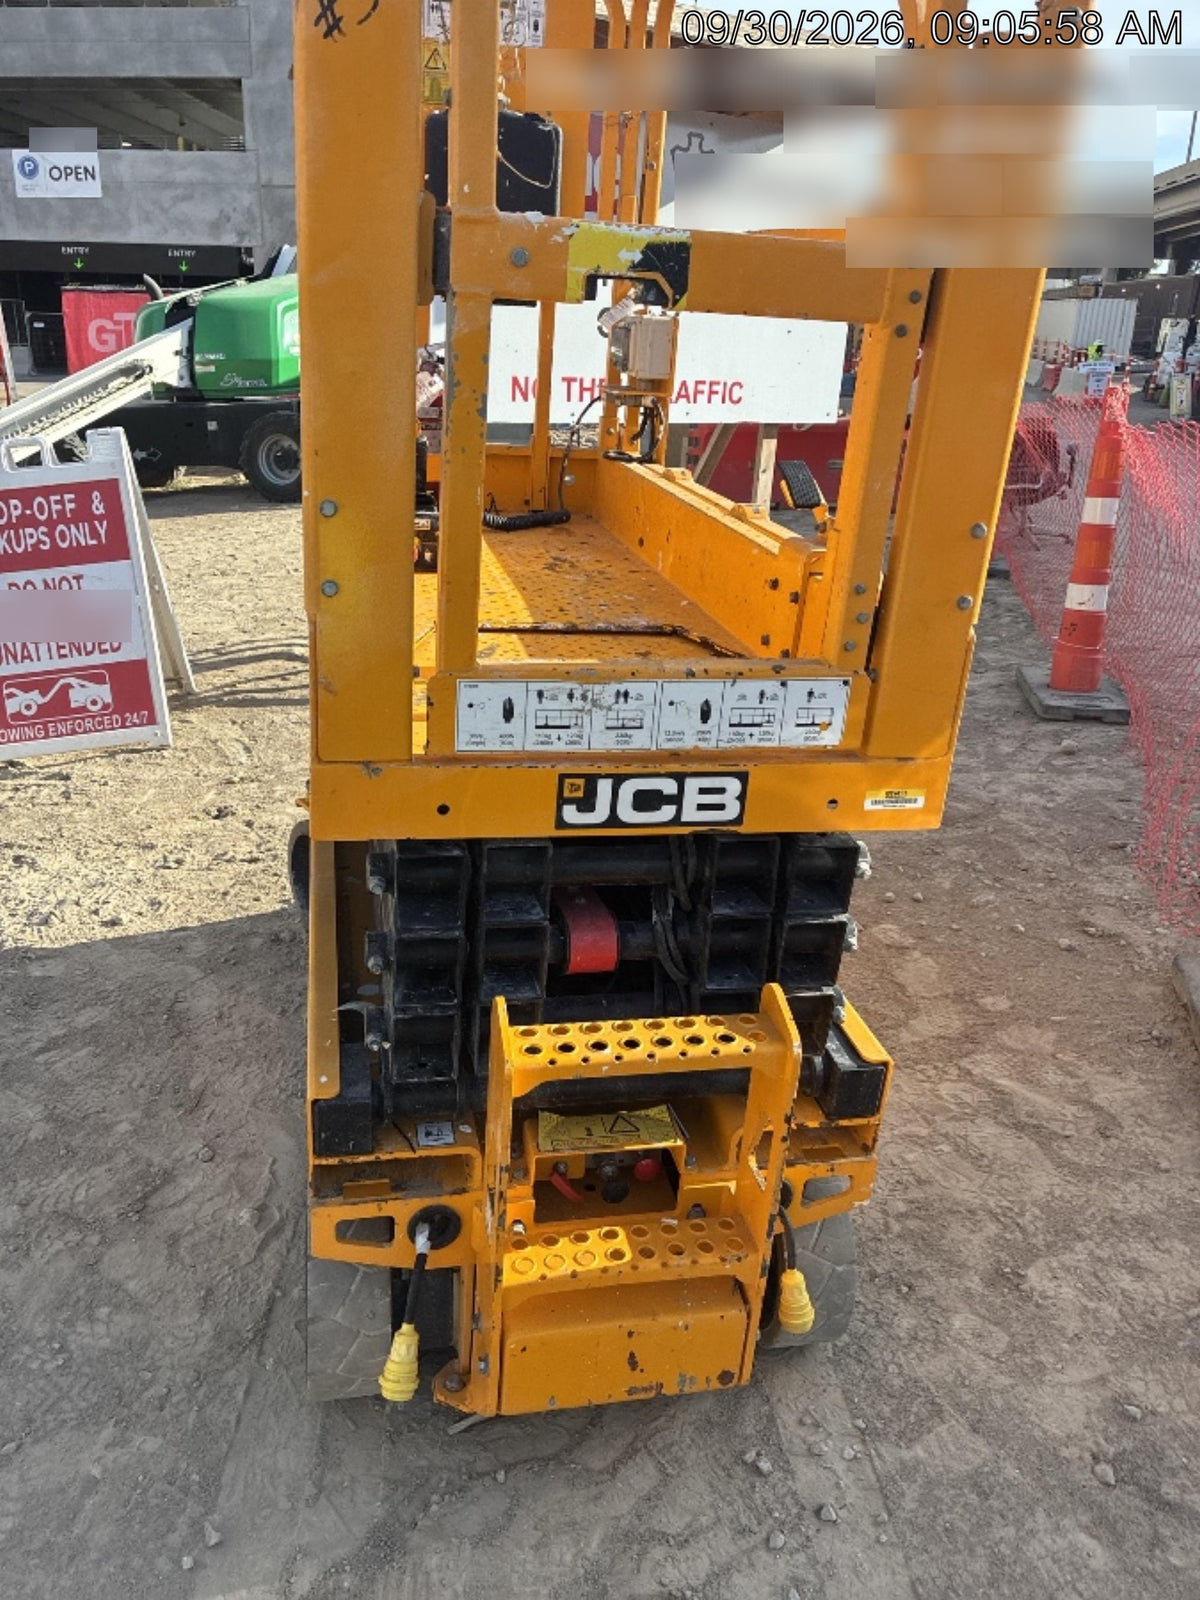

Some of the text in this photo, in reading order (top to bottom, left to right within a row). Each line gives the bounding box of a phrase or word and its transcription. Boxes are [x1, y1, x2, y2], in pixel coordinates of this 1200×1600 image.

[48, 165, 97, 182] OPEN
[61, 246, 90, 255] ENTRY
[168, 249, 196, 258] ENTRY
[511, 376, 540, 403] N
[671, 379, 745, 405] AFFIC
[91, 489, 106, 516] &
[55, 519, 108, 549] ONLY
[43, 574, 84, 590] NOT
[0, 642, 122, 668] NATTENDED
[49, 715, 122, 737] ENFORCED
[125, 710, 149, 727] 24/7
[561, 776, 743, 825] JCB
